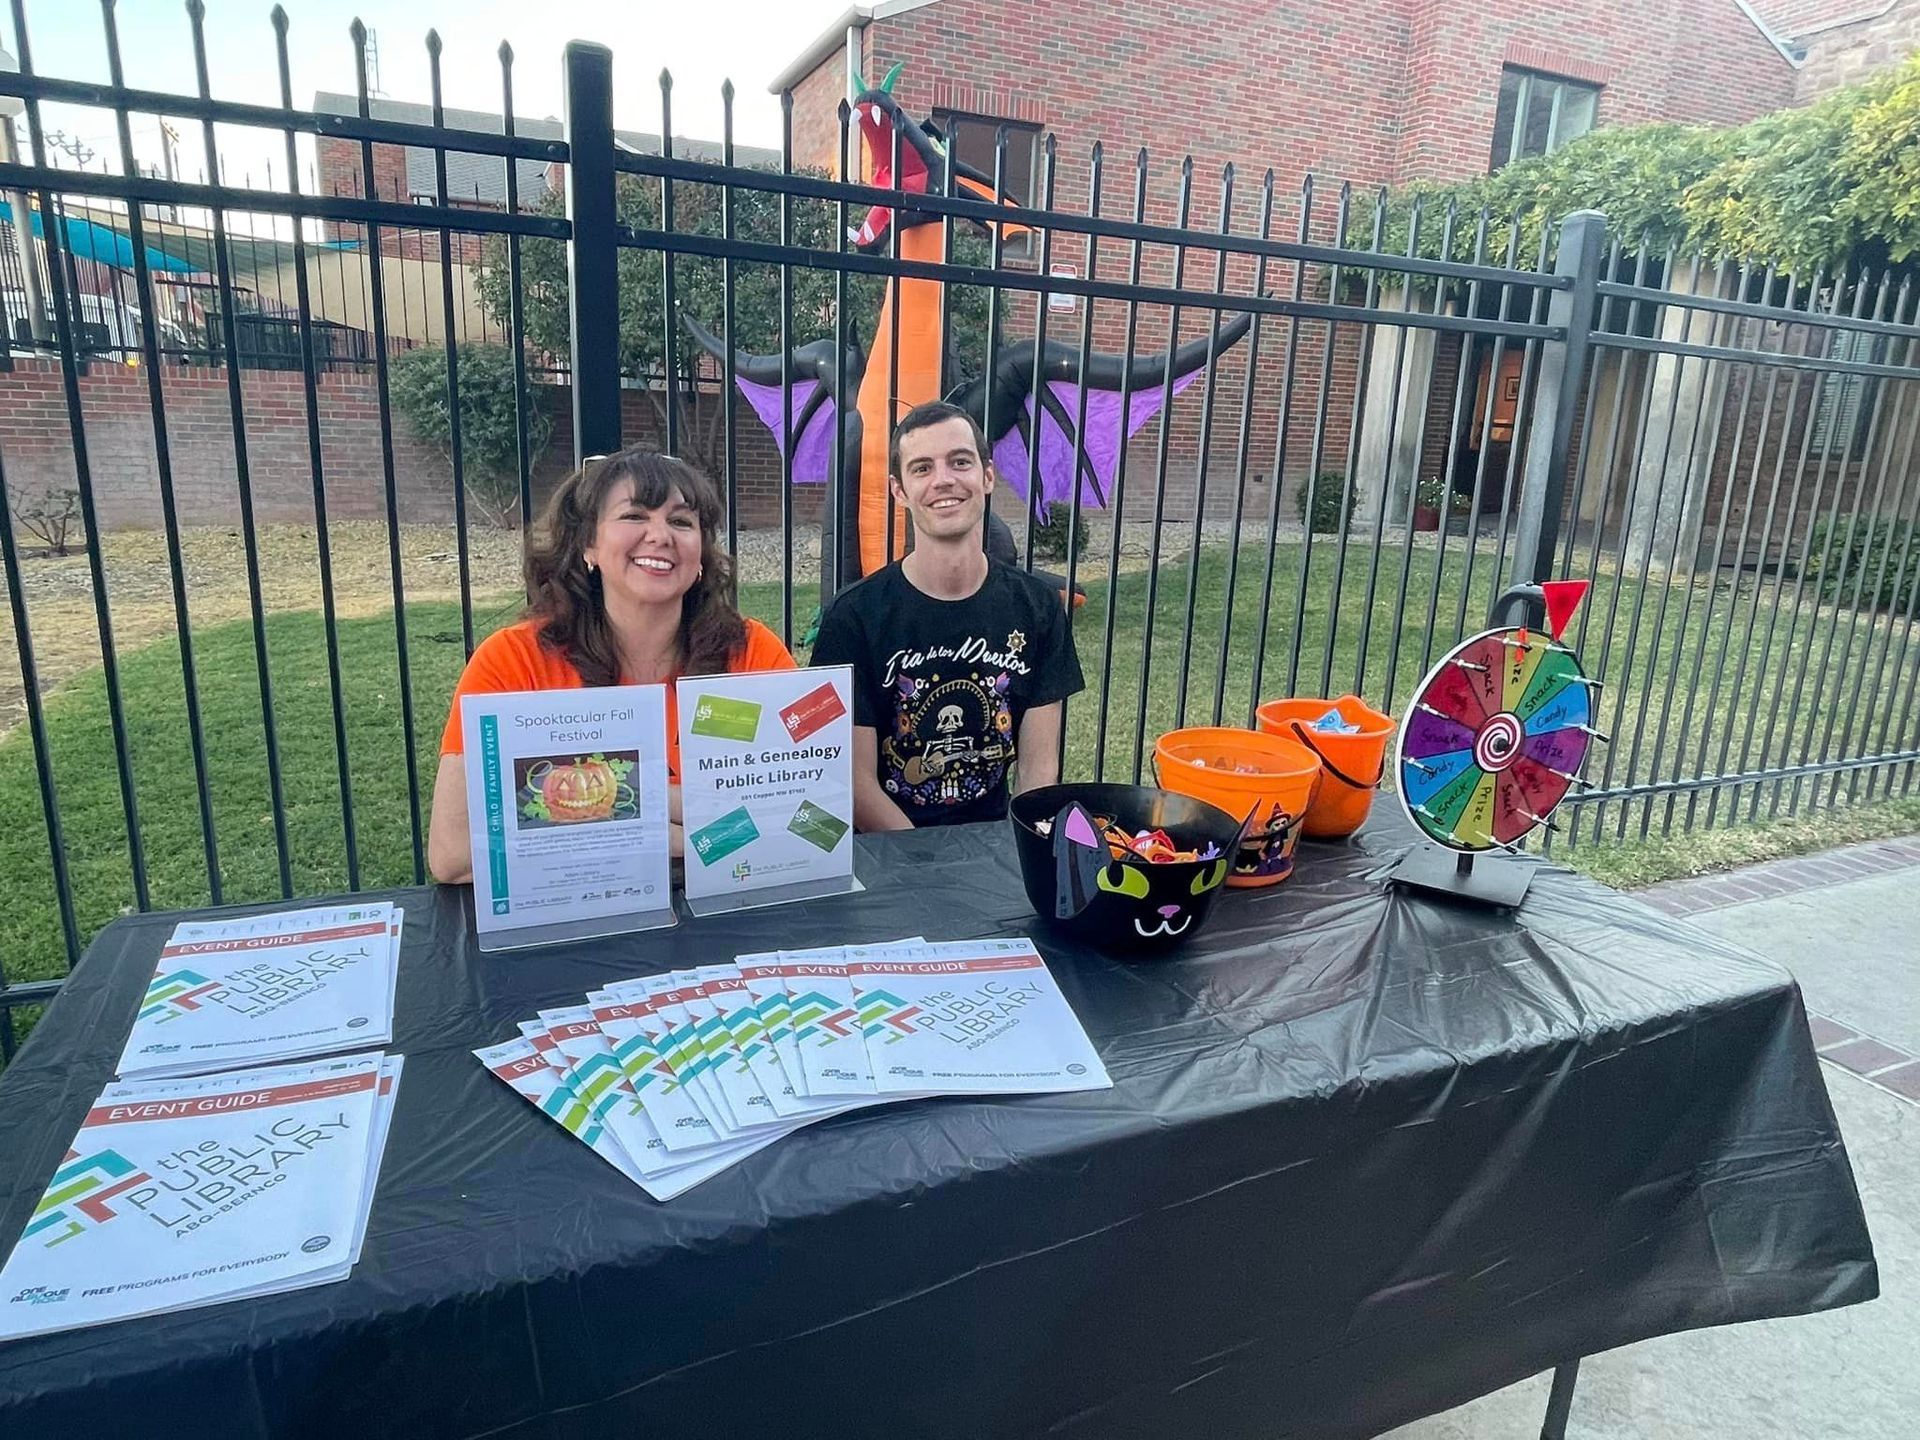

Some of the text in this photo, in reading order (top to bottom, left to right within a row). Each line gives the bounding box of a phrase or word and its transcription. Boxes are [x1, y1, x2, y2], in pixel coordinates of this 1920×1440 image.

[938, 646, 955, 657] los
[952, 636, 1031, 675] Muertos
[1524, 674, 1558, 712] Snack
[514, 708, 634, 730] Spooktacular Fall
[1536, 704, 1567, 728] Candy
[485, 724, 494, 755] EVENT
[550, 729, 603, 742] Festival
[1535, 740, 1563, 758] Prize
[699, 746, 842, 771] Main & Genealogy
[488, 760, 497, 793] FAMILY
[715, 768, 823, 790] Public Library
[1437, 782, 1469, 816] Snack
[1473, 786, 1493, 822] Prize
[490, 803, 500, 832] CHILD
[180, 934, 304, 953] EVENT GUIDE
[207, 950, 335, 1004] PUBLIC
[225, 963, 268, 981] the
[228, 947, 371, 1014] LIBRARY
[797, 966, 848, 975] EVENT
[862, 963, 917, 973] EVENT
[918, 962, 968, 972] GUIDE
[916, 981, 1008, 1030] PUBLIC
[918, 990, 956, 1008] the
[940, 981, 1044, 1043] LIBRARY
[109, 1101, 192, 1120] EVENT
[198, 1091, 272, 1111] GUIDE
[125, 1117, 305, 1210] PUBLIC
[157, 1140, 220, 1170] the
[150, 1113, 350, 1228] LIBRARY
[176, 1173, 287, 1238] ABQ-BERNCO
[82, 1252, 290, 1297] FREE PROGRAMS FOR EVERYBODY
